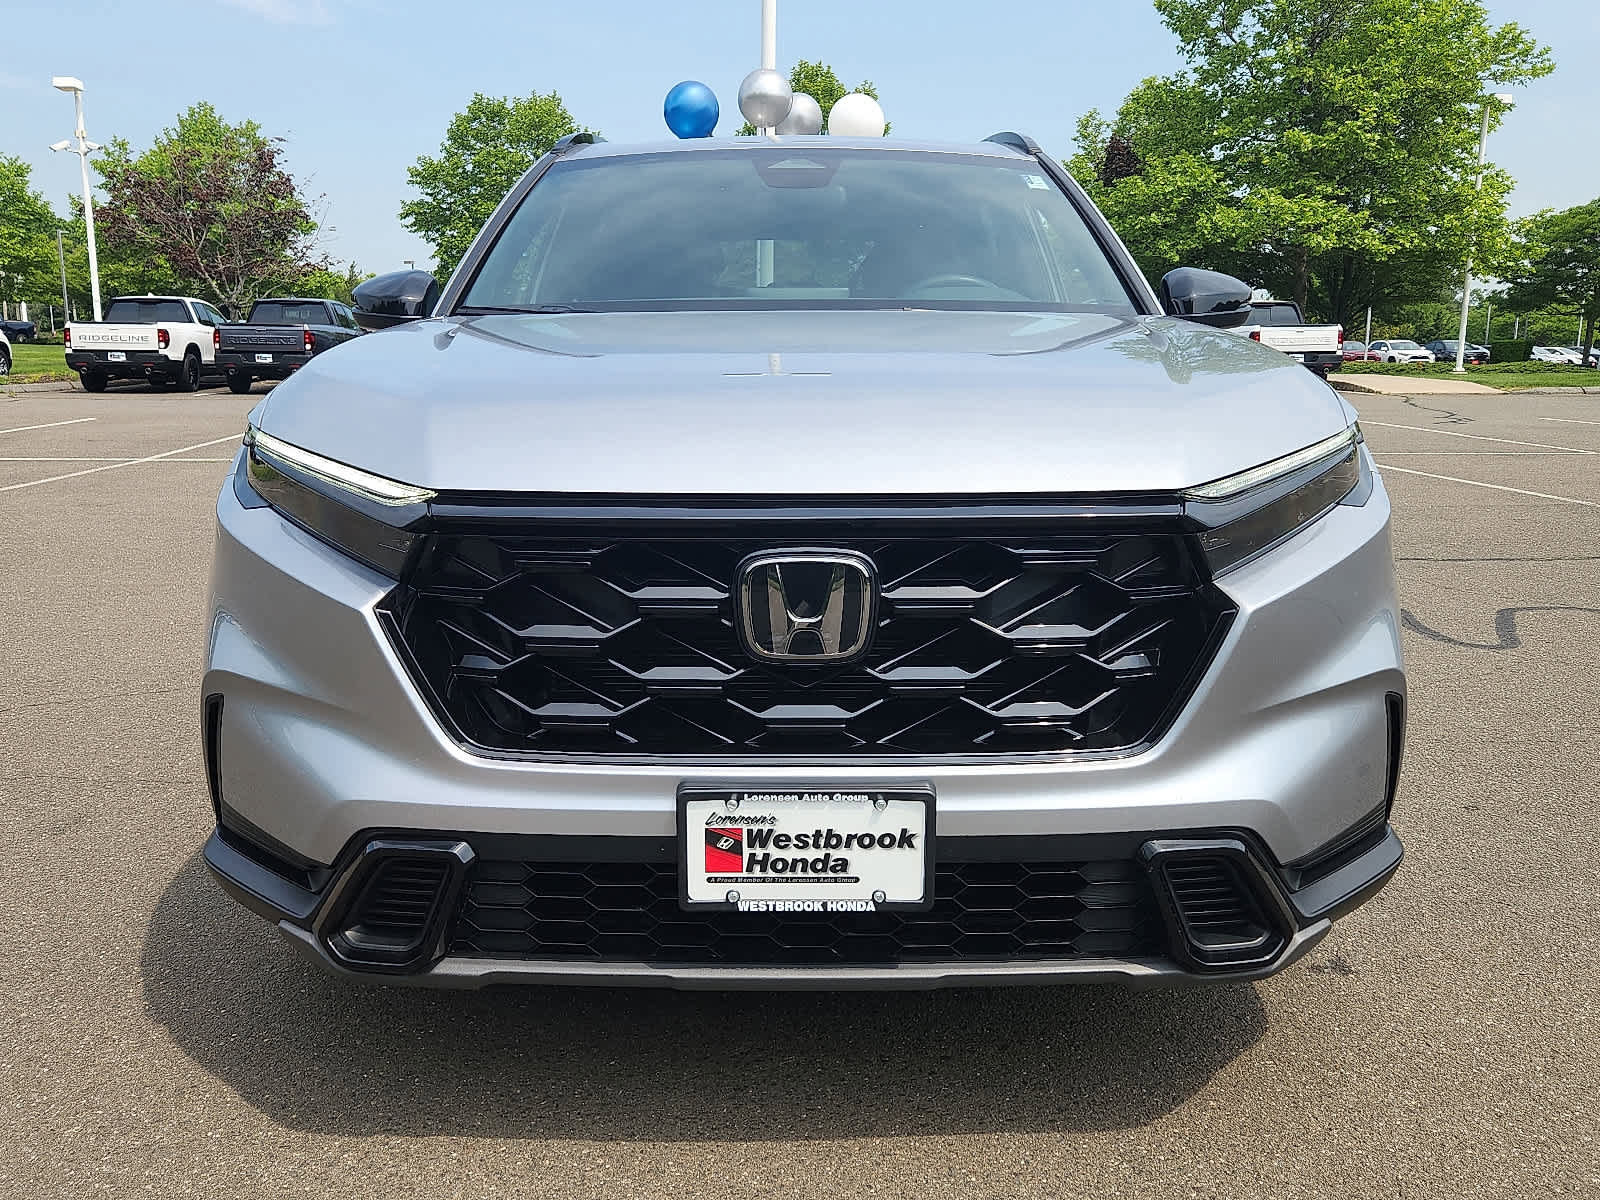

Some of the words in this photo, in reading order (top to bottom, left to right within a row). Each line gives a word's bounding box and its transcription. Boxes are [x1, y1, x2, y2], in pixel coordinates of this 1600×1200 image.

[227, 336, 297, 345] RIDGELINE
[743, 793, 799, 802] Lorensen
[802, 793, 830, 802] Auto
[832, 793, 869, 802] Group
[705, 811, 777, 826] Lorensen's
[746, 828, 917, 849] Westbrook
[745, 852, 849, 873] Honda
[737, 900, 823, 911] WESTBROOK
[827, 900, 876, 911] HONDA
